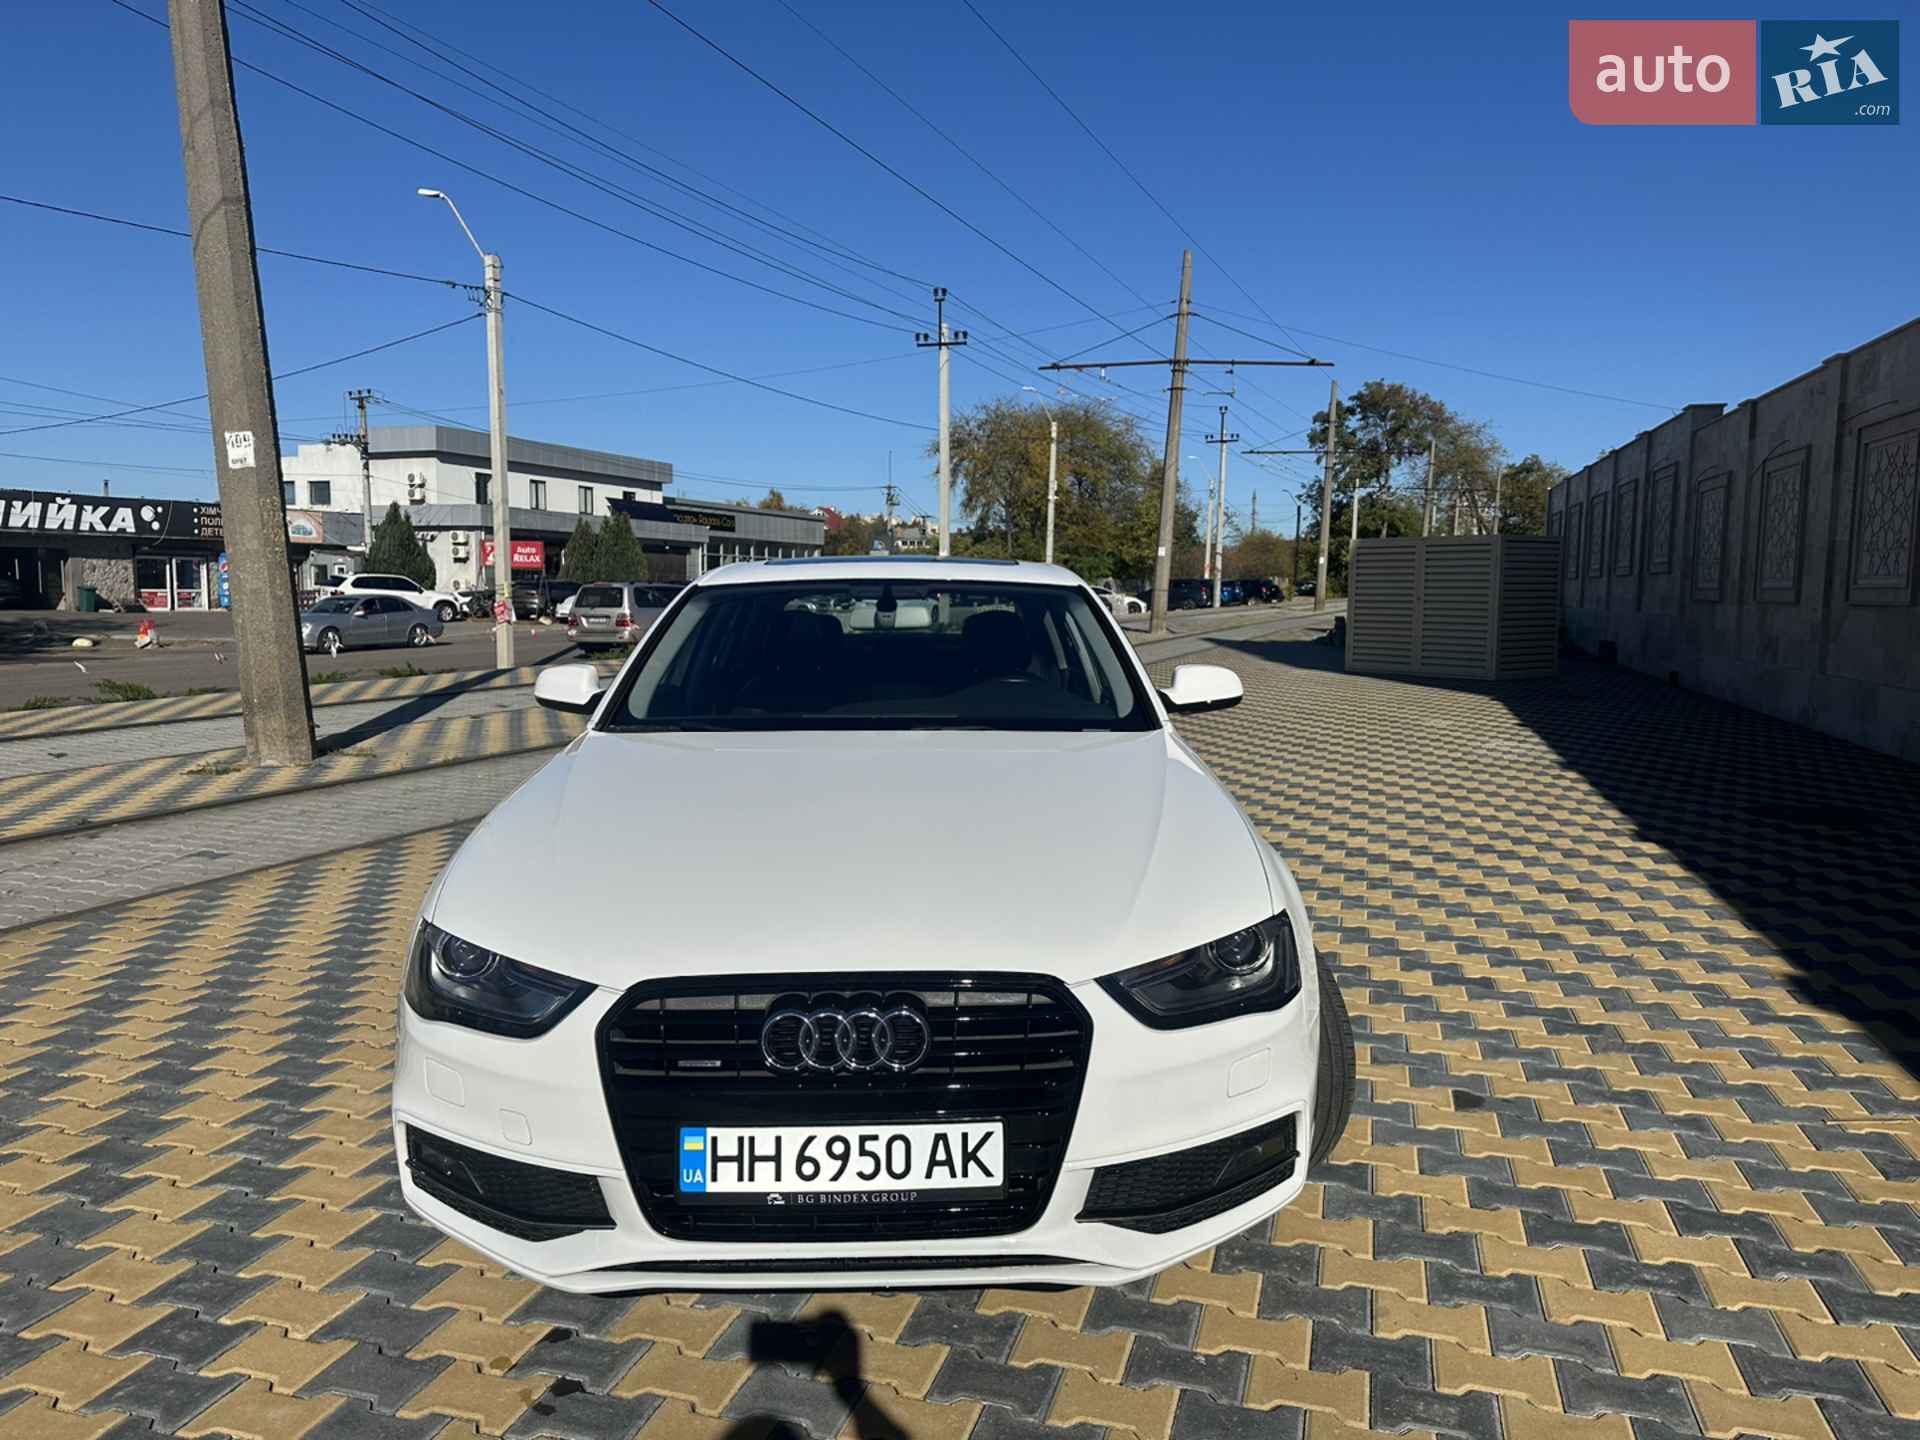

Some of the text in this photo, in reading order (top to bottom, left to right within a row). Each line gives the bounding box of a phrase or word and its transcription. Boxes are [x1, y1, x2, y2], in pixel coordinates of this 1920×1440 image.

[0, 496, 137, 533] ИЙКА
[513, 554, 541, 563] RELAX
[795, 1133, 912, 1183] 6950
[924, 1130, 996, 1180] AK
[682, 1168, 704, 1183] UA
[797, 1191, 918, 1204] BG BINDEX GROUP
